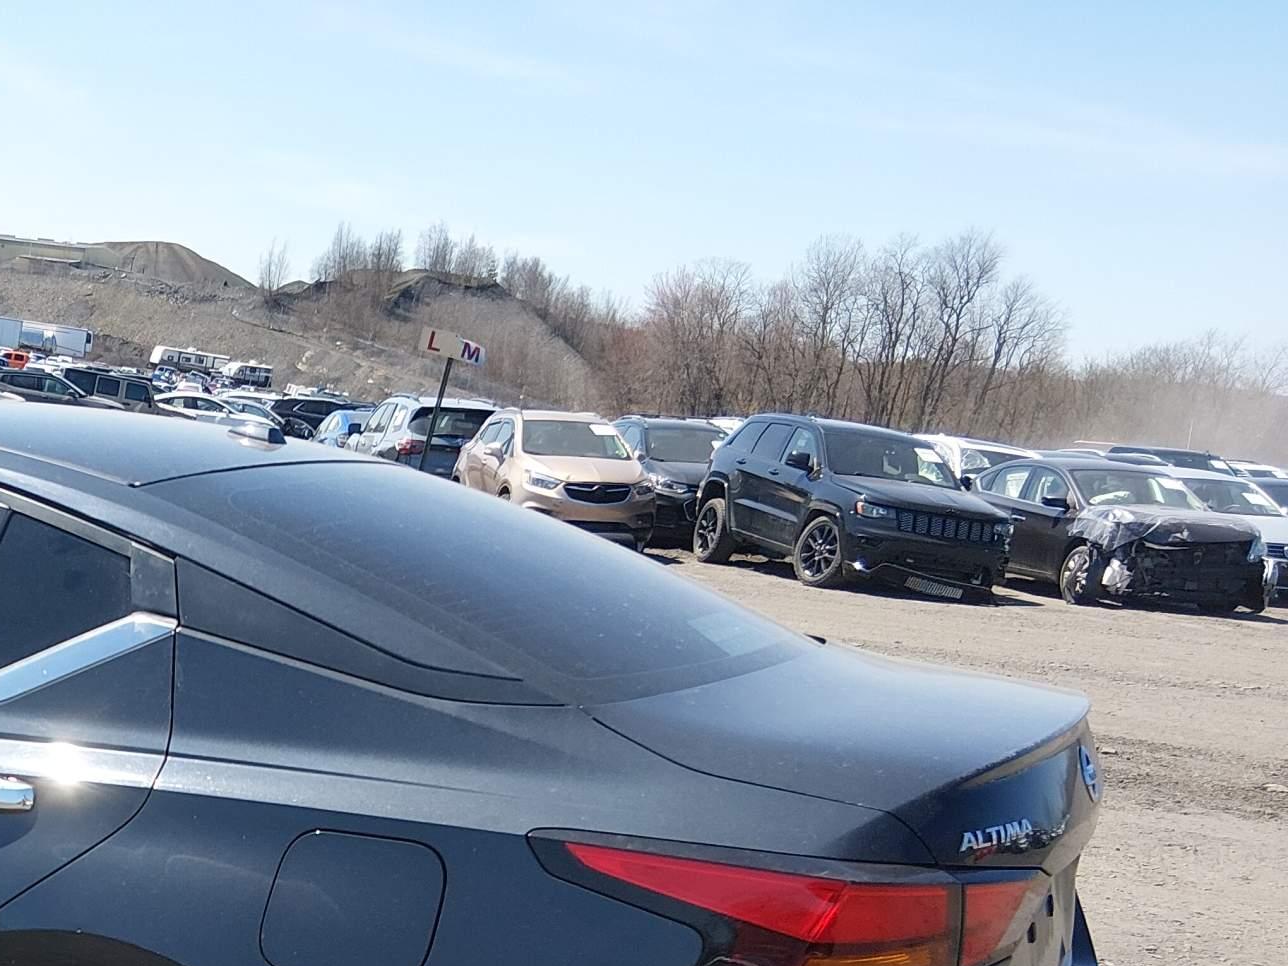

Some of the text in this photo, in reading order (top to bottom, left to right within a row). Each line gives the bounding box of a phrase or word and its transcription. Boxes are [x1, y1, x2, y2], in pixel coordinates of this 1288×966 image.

[427, 330, 441, 352] L
[460, 341, 481, 363] M
[959, 818, 1032, 852] ALTIMA
